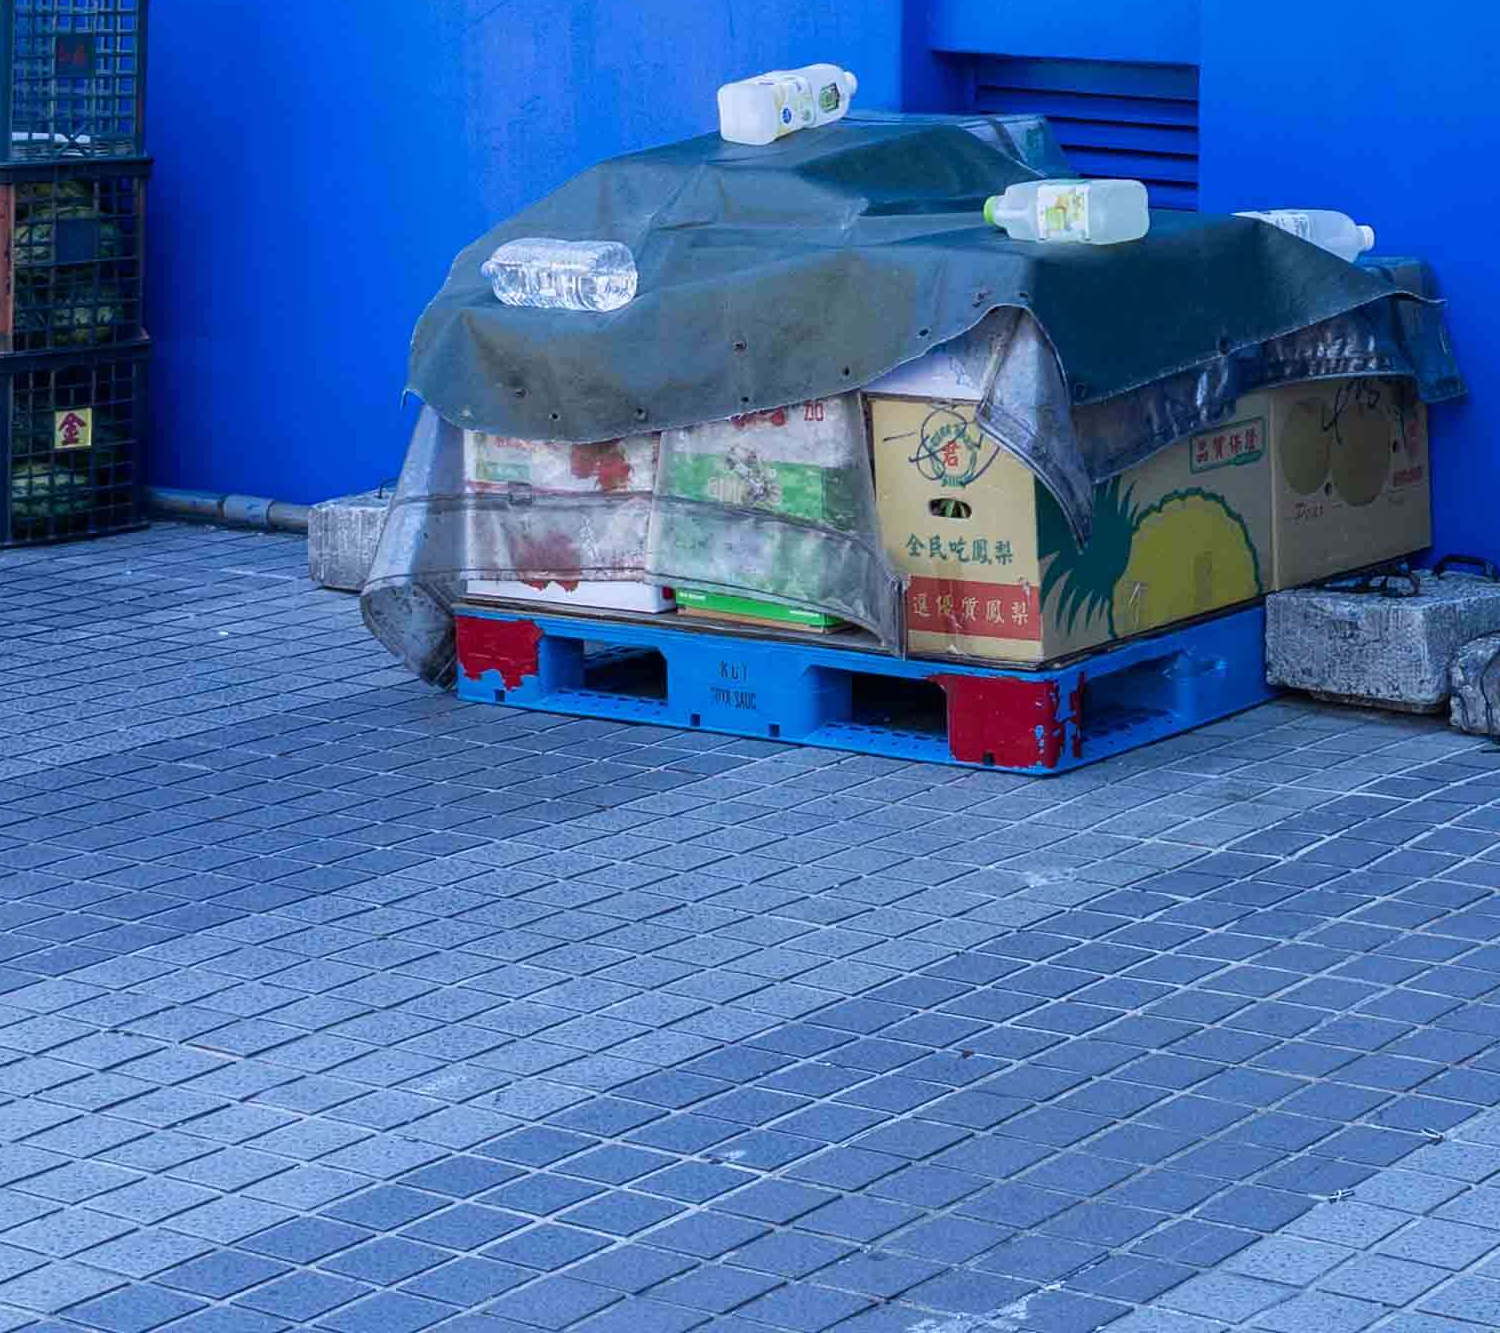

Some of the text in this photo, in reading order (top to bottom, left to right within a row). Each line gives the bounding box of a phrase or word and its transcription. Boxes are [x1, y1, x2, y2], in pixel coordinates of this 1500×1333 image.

[905, 533, 1014, 565] 全民吃鳳梨
